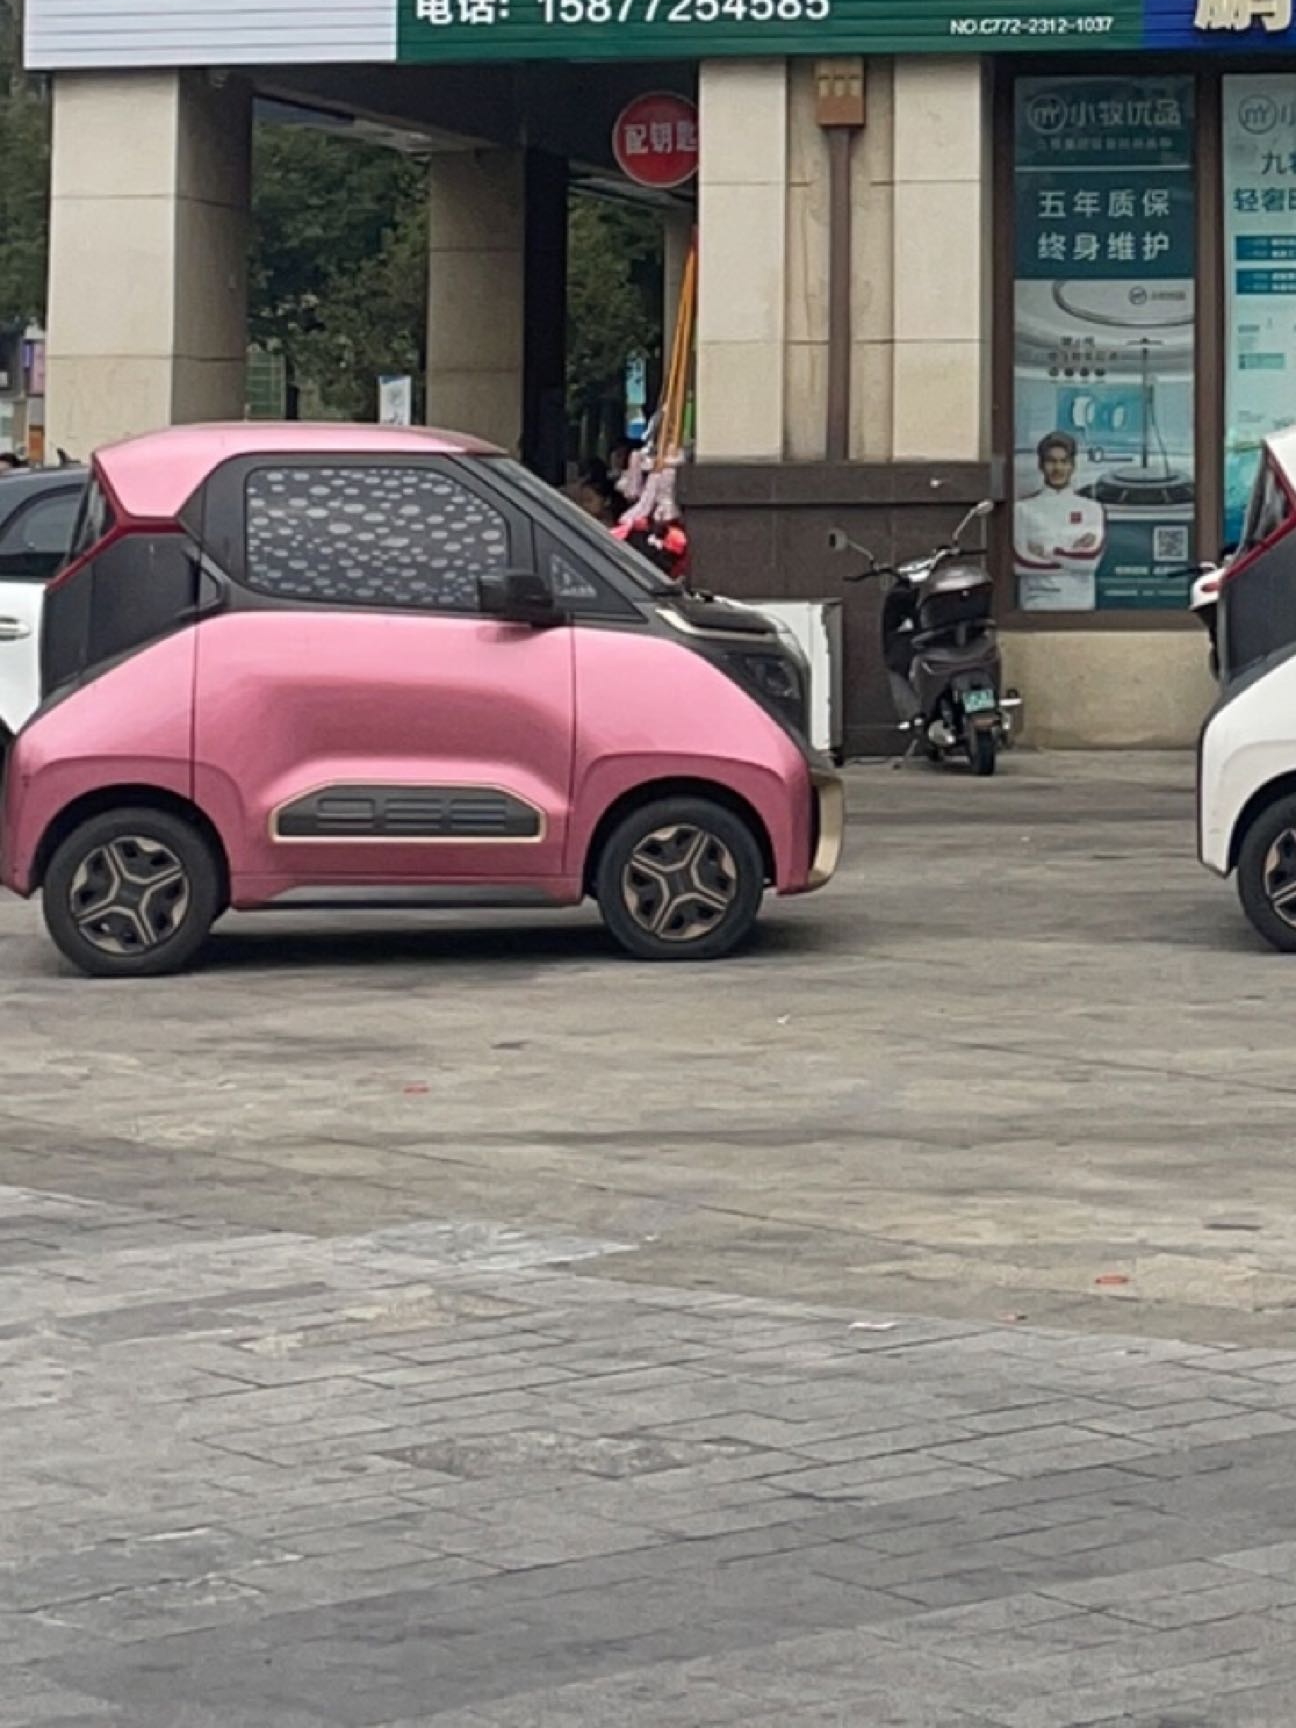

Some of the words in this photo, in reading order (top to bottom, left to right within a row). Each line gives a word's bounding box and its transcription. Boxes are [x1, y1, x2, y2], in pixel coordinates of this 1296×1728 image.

[1038, 189, 1170, 218] 五年质保
[1038, 232, 1169, 261] 终身维护
